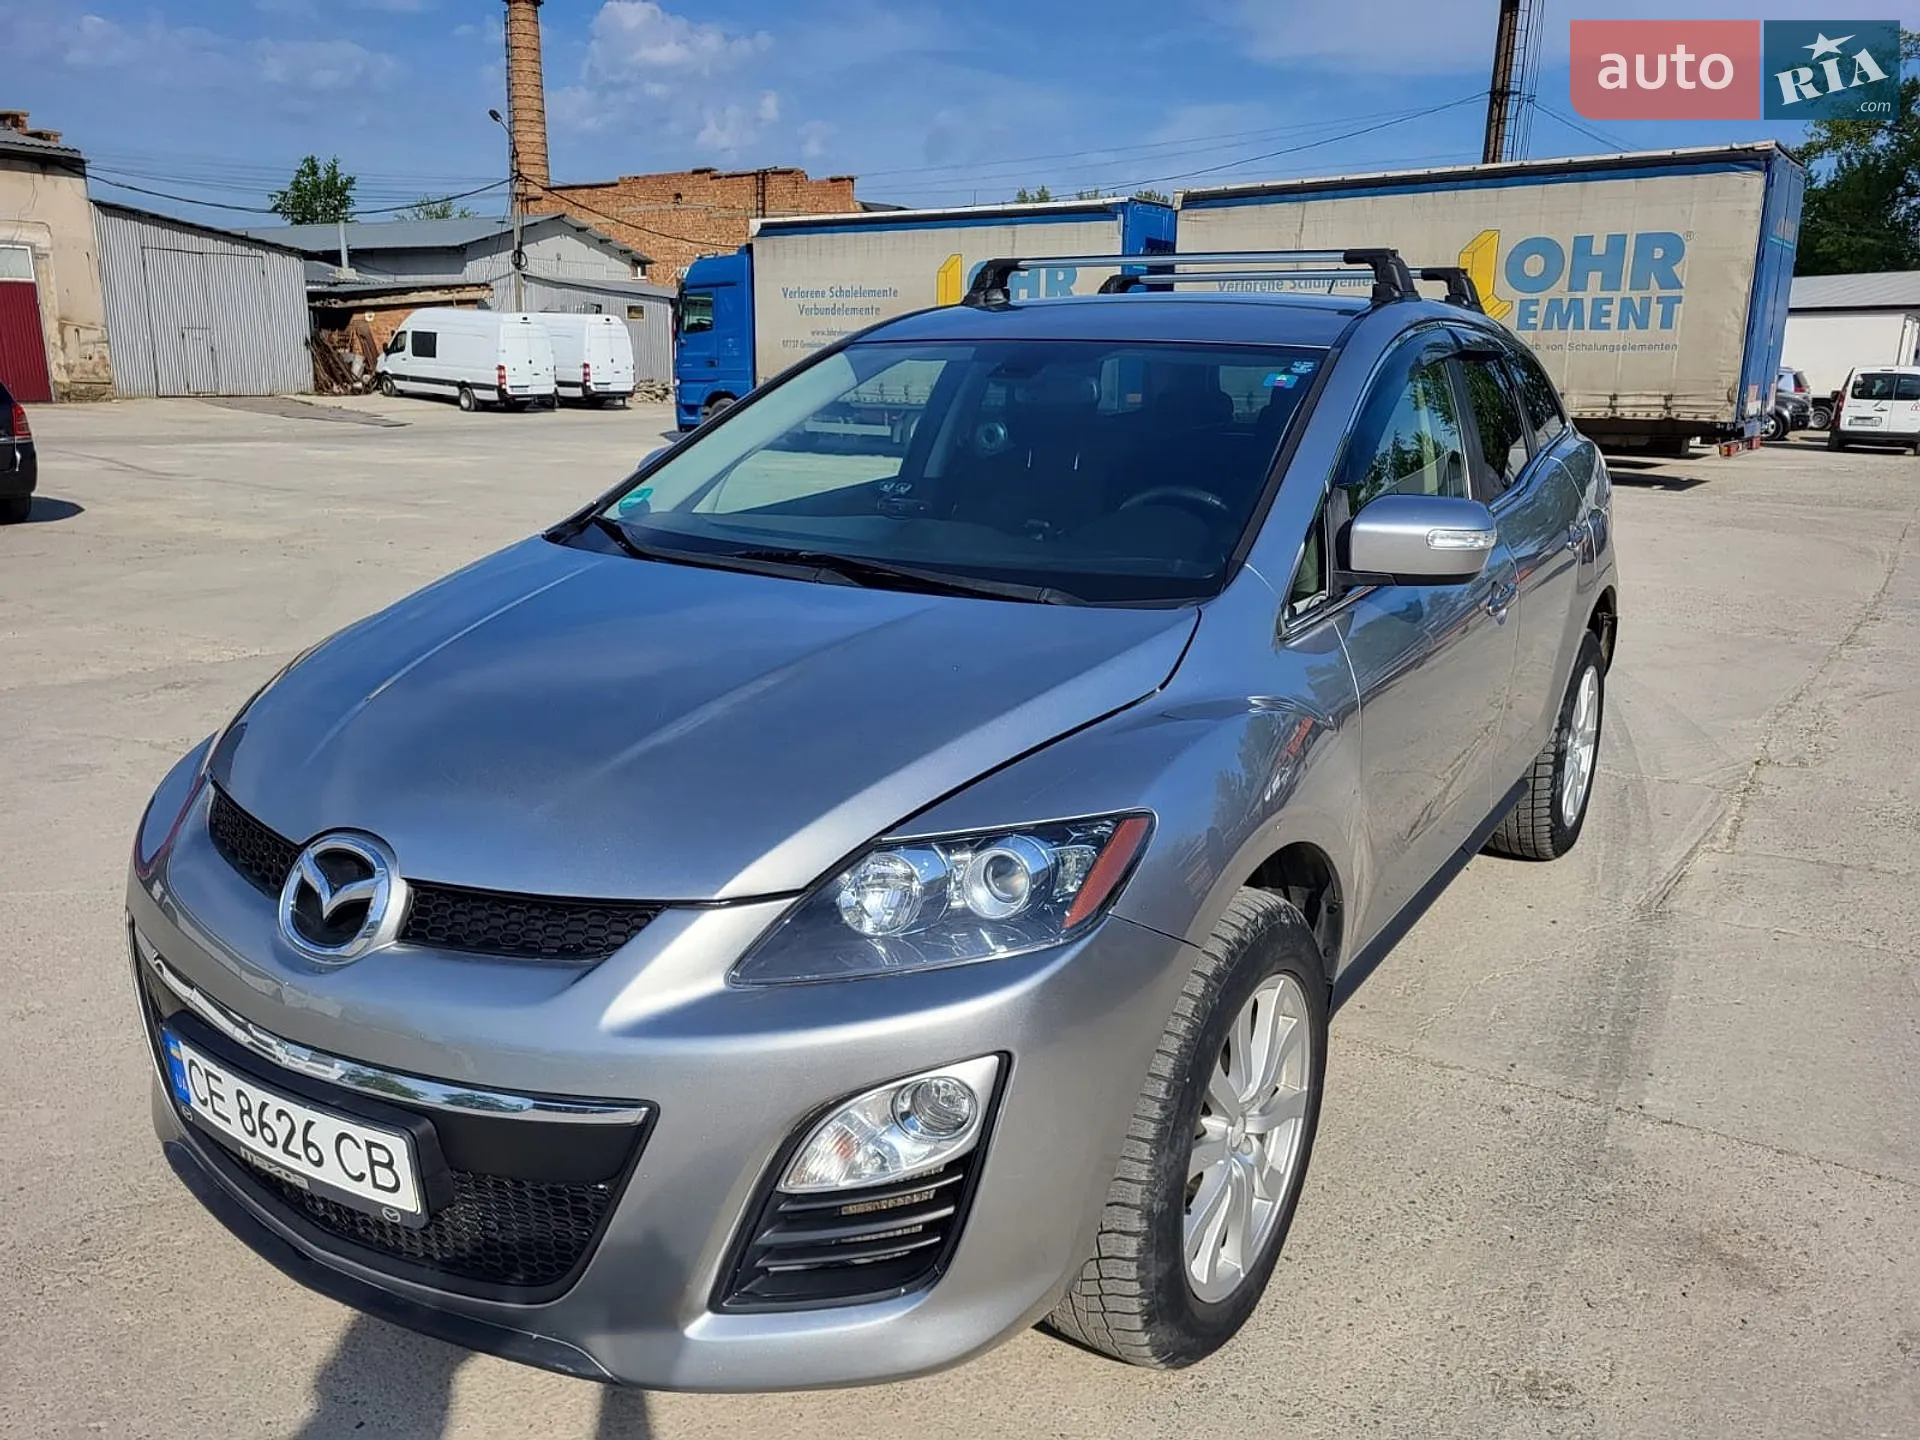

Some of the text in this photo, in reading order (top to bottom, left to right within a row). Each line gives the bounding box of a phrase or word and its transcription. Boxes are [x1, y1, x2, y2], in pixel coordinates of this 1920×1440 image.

[782, 285, 899, 299] Verlorene Schalelemente
[798, 302, 881, 316] Verbundelemente
[188, 1058, 401, 1194] CE 8626 CB
